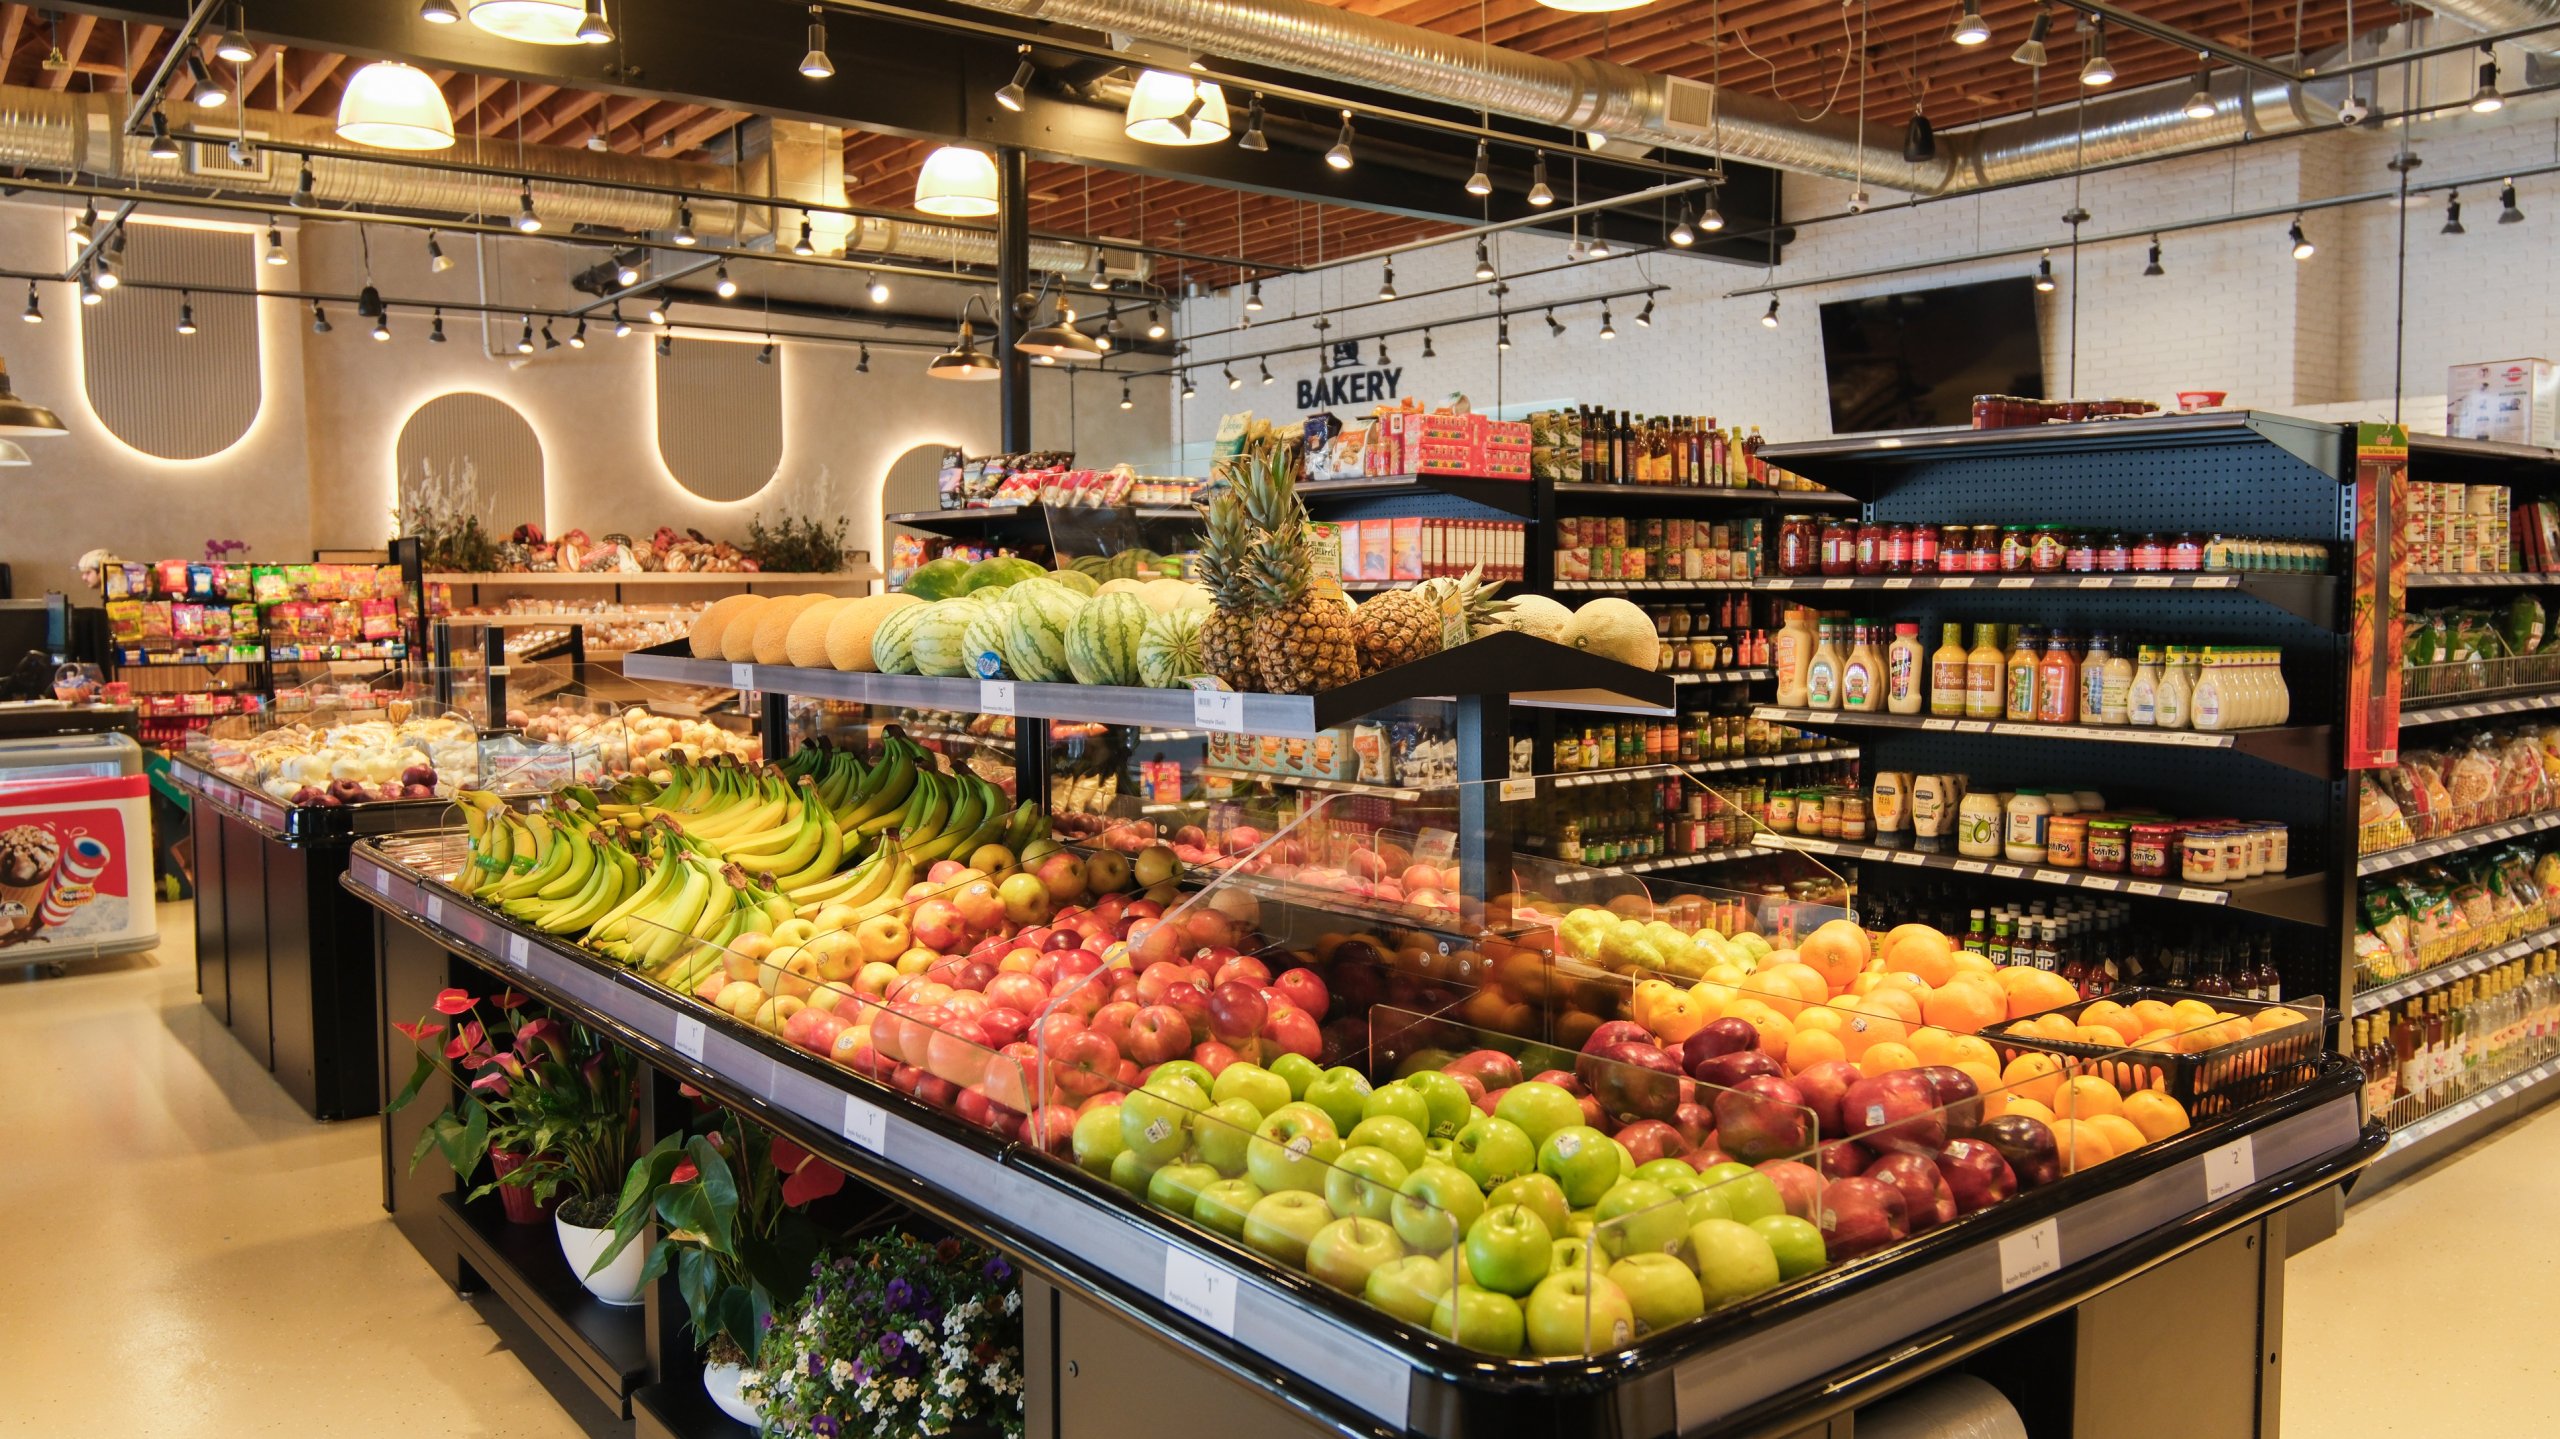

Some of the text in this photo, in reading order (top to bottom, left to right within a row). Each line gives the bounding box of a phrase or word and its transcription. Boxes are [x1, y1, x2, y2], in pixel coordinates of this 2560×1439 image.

[1297, 367, 1403, 409] BAKERY
[1989, 951, 2006, 965] HP
[2012, 954, 2031, 967] HP
[2035, 957, 2054, 970] HP
